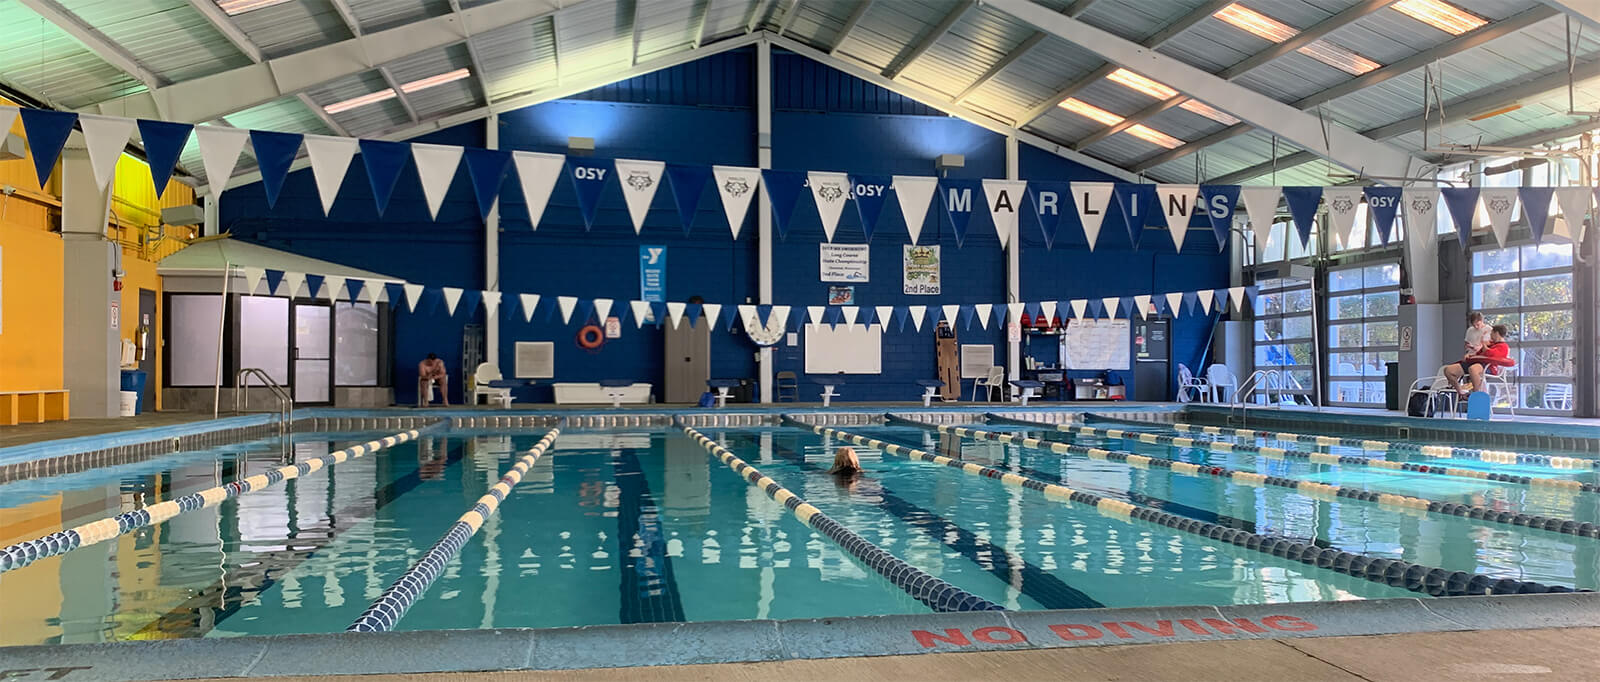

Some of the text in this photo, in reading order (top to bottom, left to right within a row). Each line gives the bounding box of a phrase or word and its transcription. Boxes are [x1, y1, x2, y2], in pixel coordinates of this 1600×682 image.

[575, 167, 606, 180] OSY
[856, 184, 884, 197] OSY
[949, 188, 1229, 218] MARLINS
[1370, 196, 1396, 207] OSY
[905, 284, 939, 293] 2nd Place
[911, 615, 1319, 648] NO DIVING
